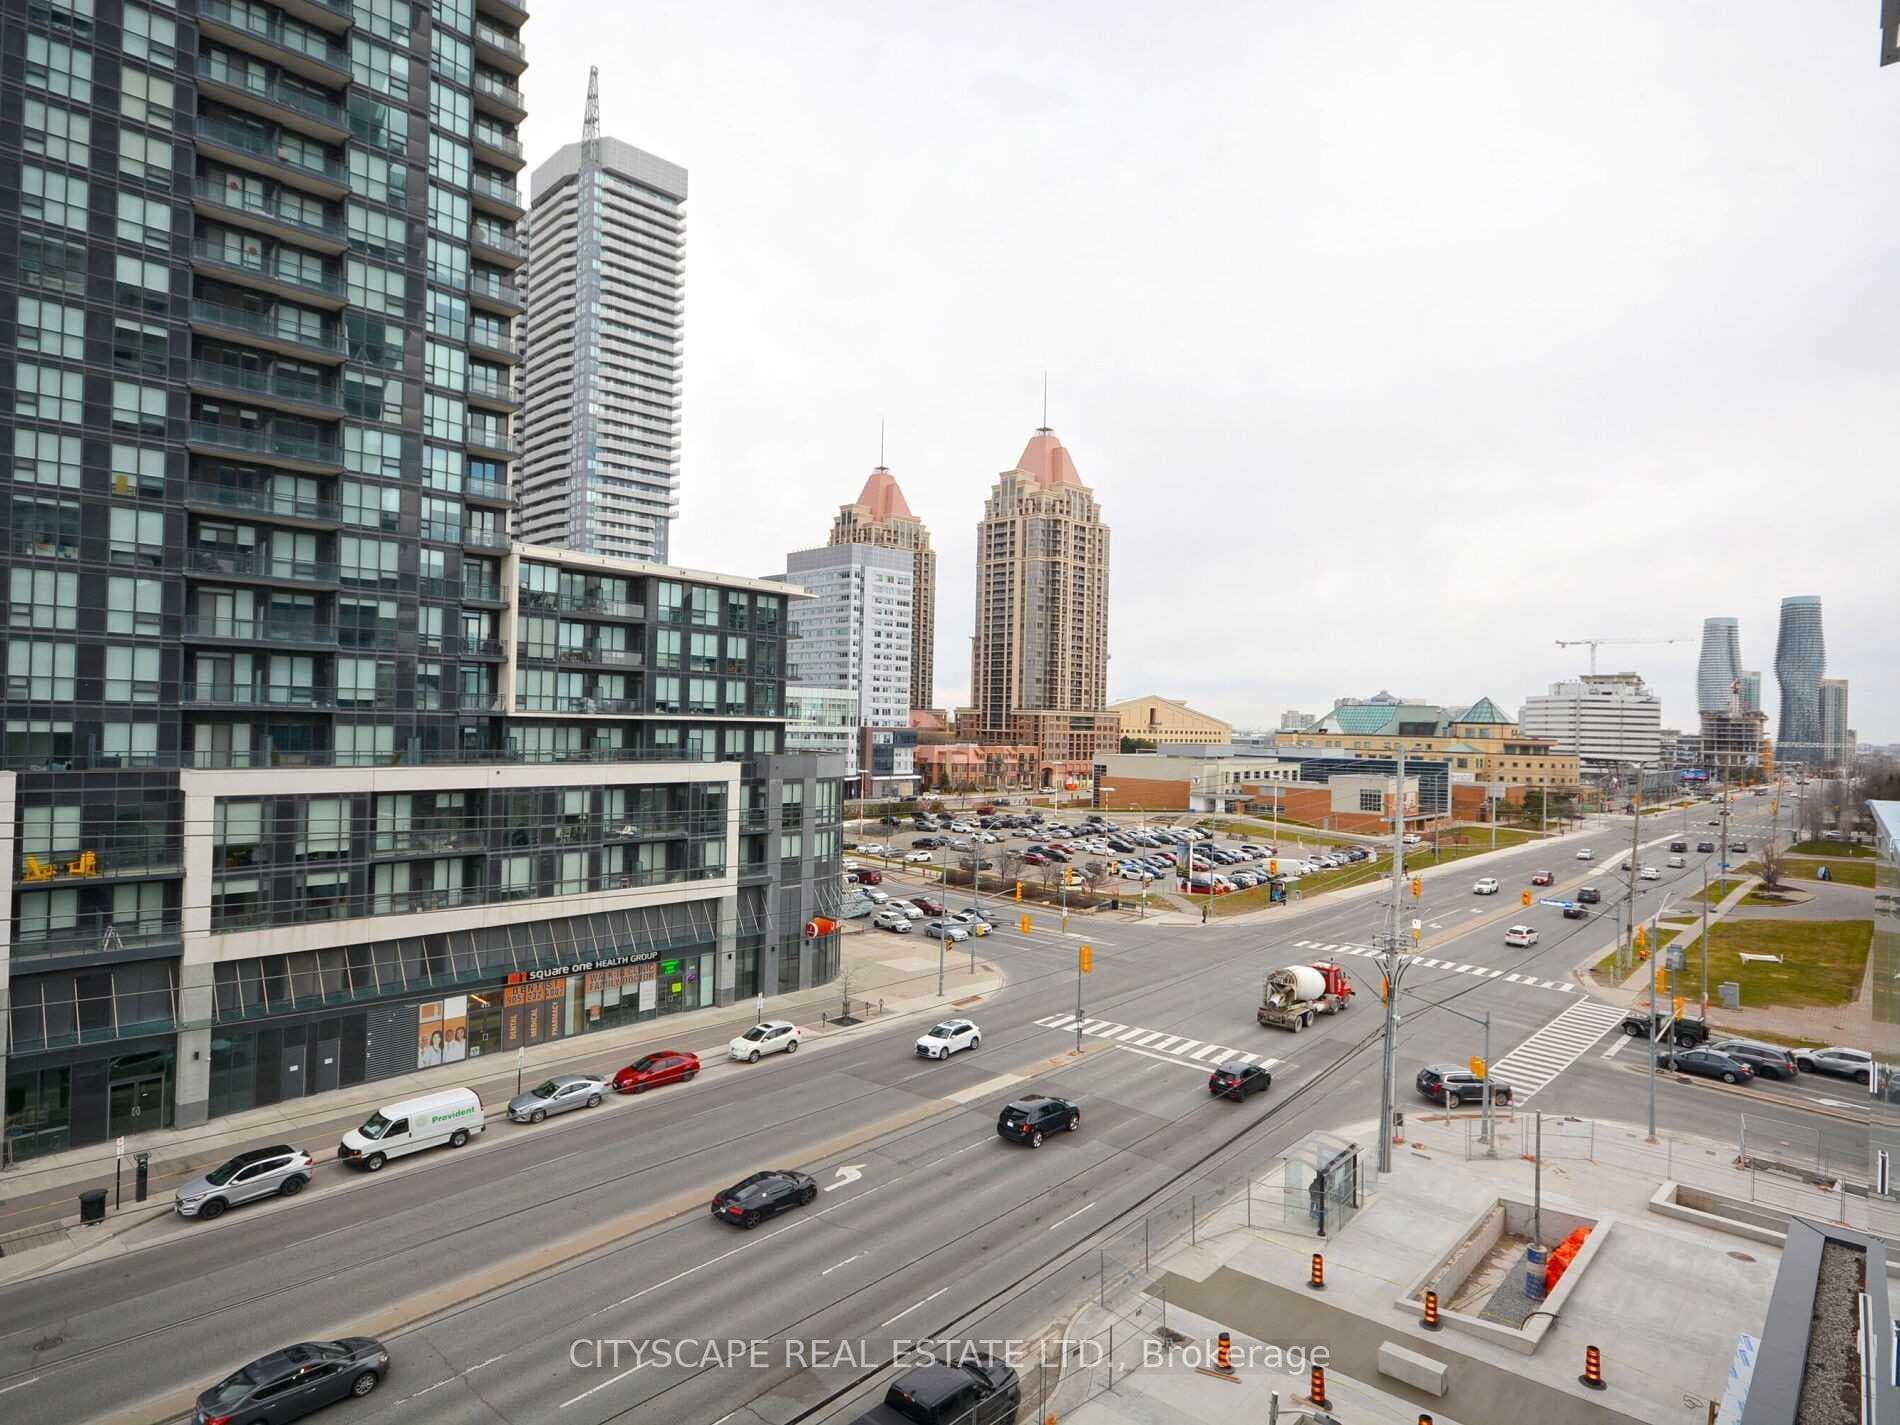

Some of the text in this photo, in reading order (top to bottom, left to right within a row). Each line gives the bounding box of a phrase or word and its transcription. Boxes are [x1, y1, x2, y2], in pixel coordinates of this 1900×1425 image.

[529, 952, 658, 980] square one HEALTH GROUP
[432, 1106, 475, 1124] Provident
